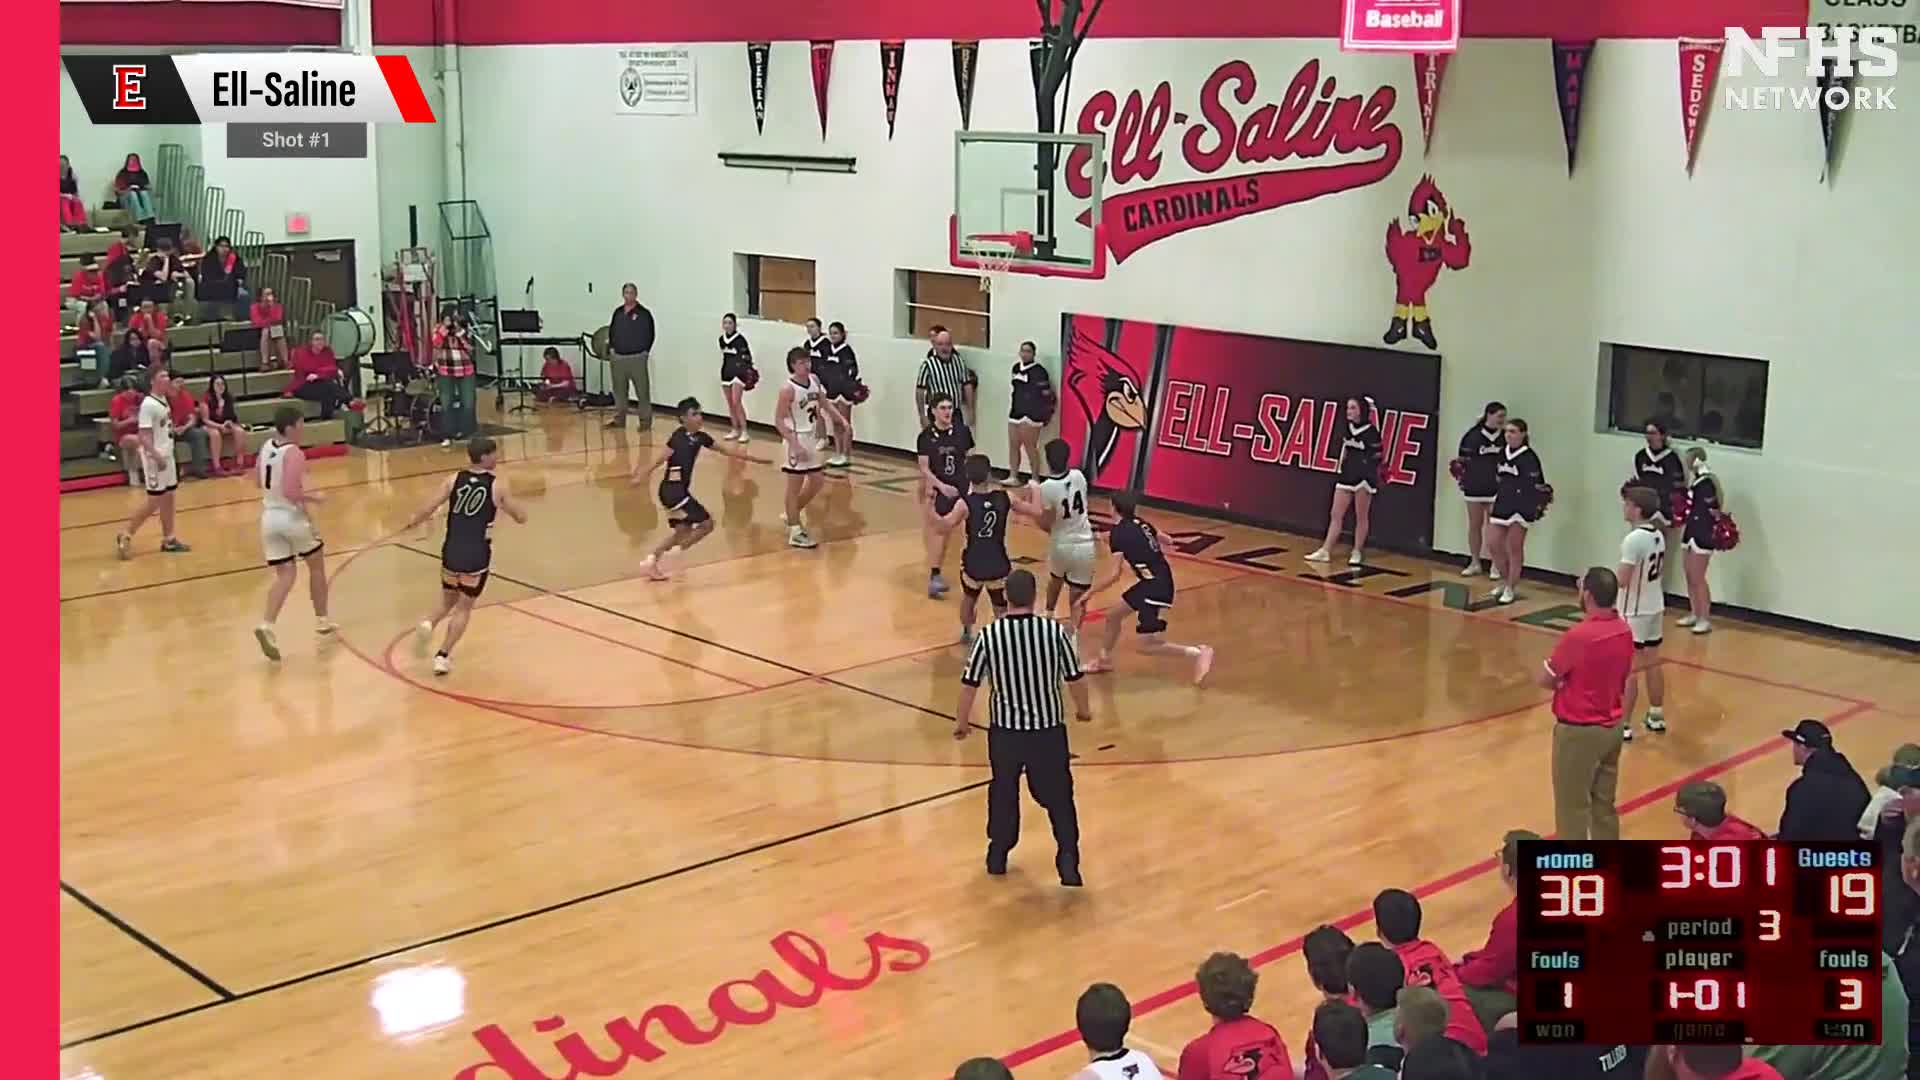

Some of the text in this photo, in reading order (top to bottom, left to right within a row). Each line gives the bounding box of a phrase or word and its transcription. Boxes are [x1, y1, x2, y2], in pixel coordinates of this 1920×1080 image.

[1366, 9, 1444, 28] Baseball
[1066, 58, 1398, 199] Ell-Saline
[1123, 179, 1260, 233] CARDINALS
[1157, 380, 1429, 486] ELL-SALNE
[453, 484, 487, 517] 10
[1061, 490, 1085, 519] 14
[977, 510, 997, 539] 2
